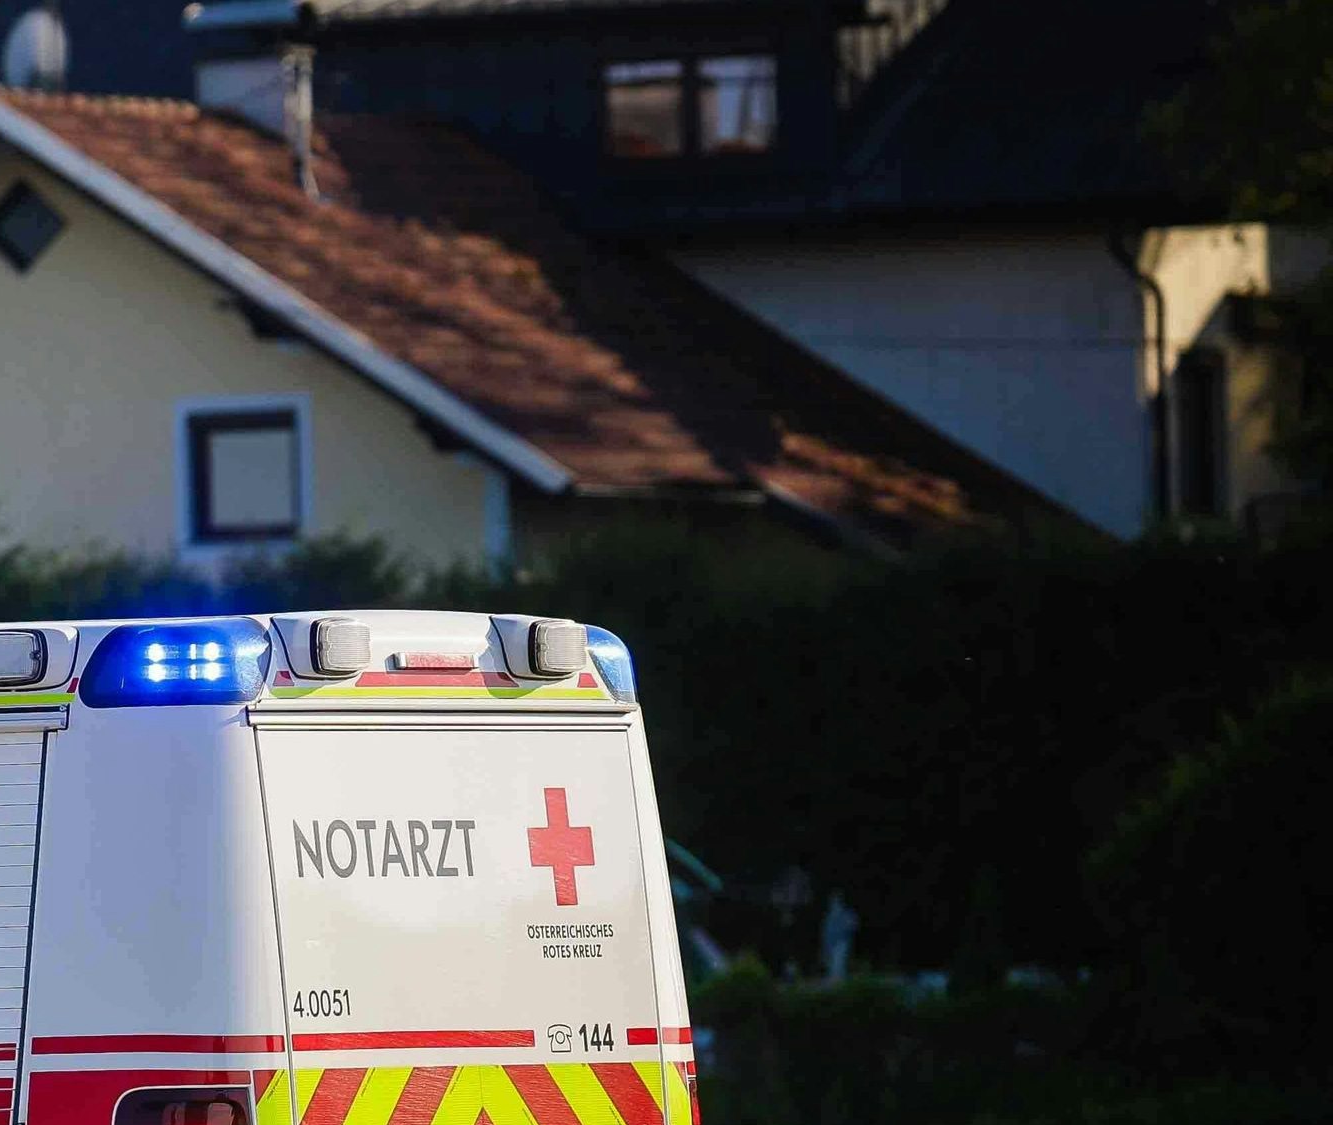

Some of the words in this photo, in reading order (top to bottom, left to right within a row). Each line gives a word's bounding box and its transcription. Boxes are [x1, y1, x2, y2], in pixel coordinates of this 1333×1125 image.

[292, 819, 476, 879] NOTARZT
[526, 923, 614, 939] ÖSTERREICHISCHES
[542, 944, 571, 958] ROTES
[572, 944, 603, 958] KREUZ
[293, 989, 351, 1018] 4.0051
[579, 1023, 614, 1052] 144
